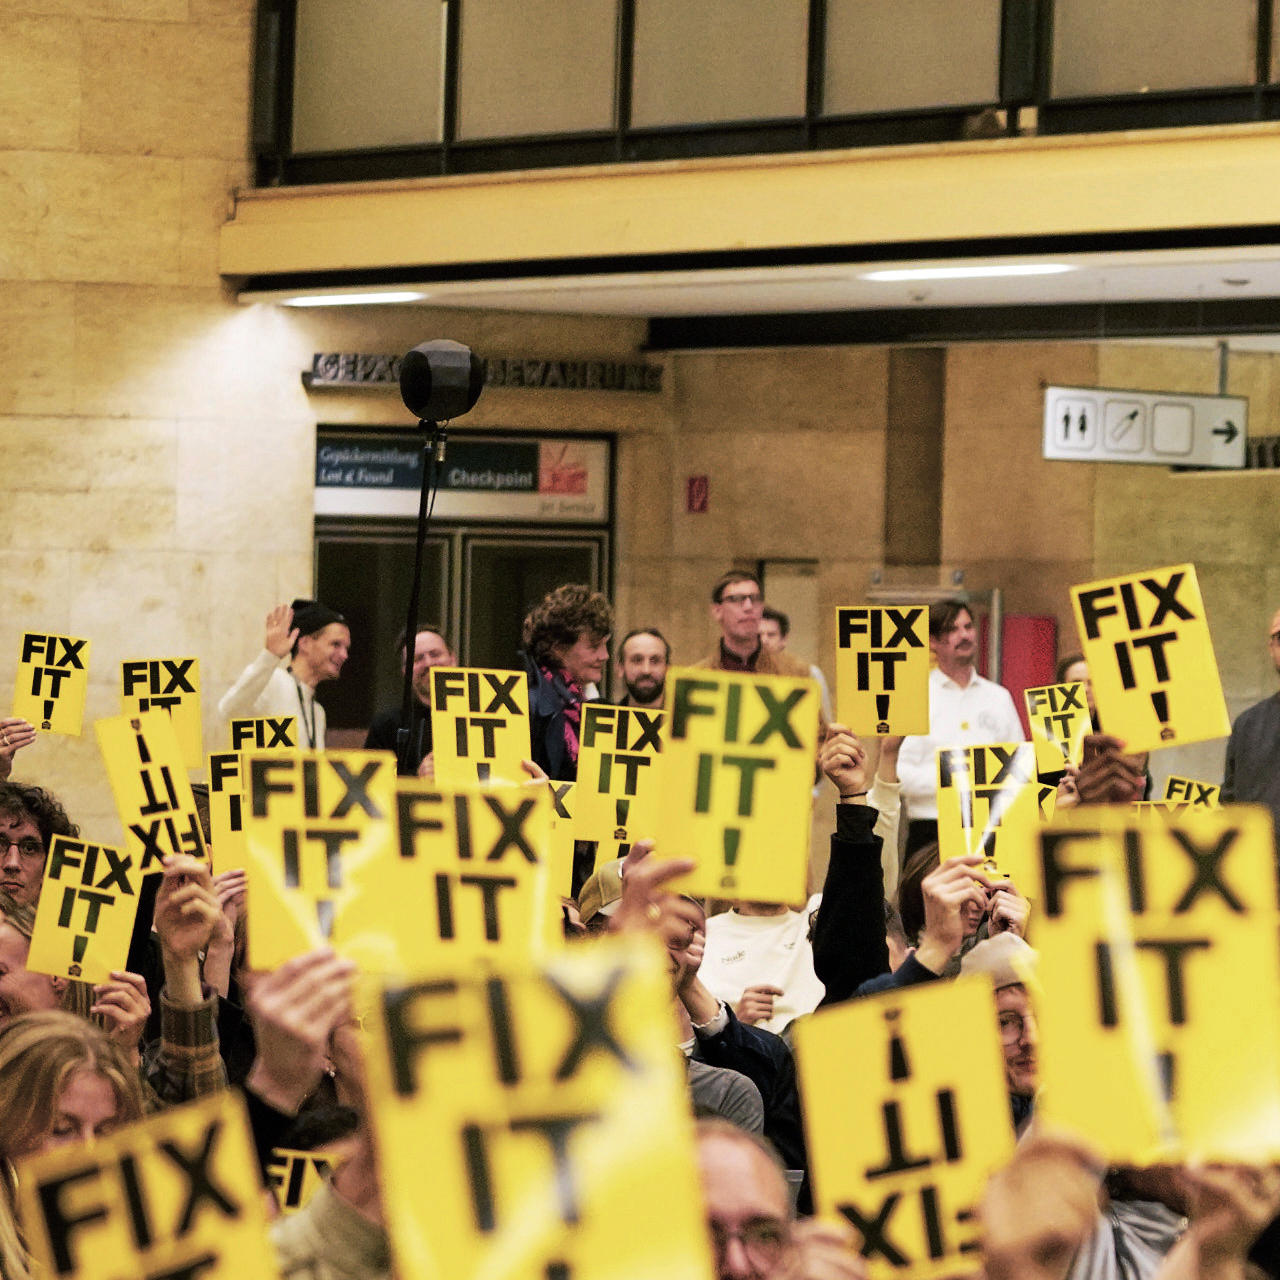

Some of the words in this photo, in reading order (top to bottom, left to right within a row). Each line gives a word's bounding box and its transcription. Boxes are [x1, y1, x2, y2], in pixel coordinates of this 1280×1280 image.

[449, 470, 534, 489] Checkpoint
[839, 609, 924, 649] FIX
[1078, 572, 1195, 641] FIX
[22, 633, 87, 669] FIX
[857, 652, 906, 691] IT
[1114, 631, 1178, 691] IT
[32, 669, 70, 698] IT
[122, 659, 196, 696] FIX
[434, 671, 523, 715] FIX
[1030, 684, 1084, 716] FIX
[232, 718, 295, 750] FIX
[583, 708, 664, 752] FIX
[670, 678, 808, 749] FIX
[876, 694, 890, 733] !
[1044, 713, 1075, 740] IT
[1150, 691, 1177, 741] !
[455, 717, 506, 758] IT
[140, 766, 179, 816] IT
[250, 760, 385, 819] FIX
[599, 753, 650, 795] IT
[694, 753, 776, 816] IT
[939, 749, 1032, 788] FIX
[1166, 778, 1220, 805] FIX
[396, 789, 541, 863] FIX
[961, 789, 1005, 829] IT
[48, 838, 135, 895] FIX
[284, 830, 359, 889] IT
[1038, 828, 1247, 917] FIX
[58, 887, 115, 933] IT
[435, 873, 517, 941] IT
[1095, 939, 1211, 1029] IT
[380, 967, 640, 1096] FIX
[864, 1088, 963, 1181] IT
[462, 1115, 603, 1233] IT
[35, 1117, 241, 1280] FIX
